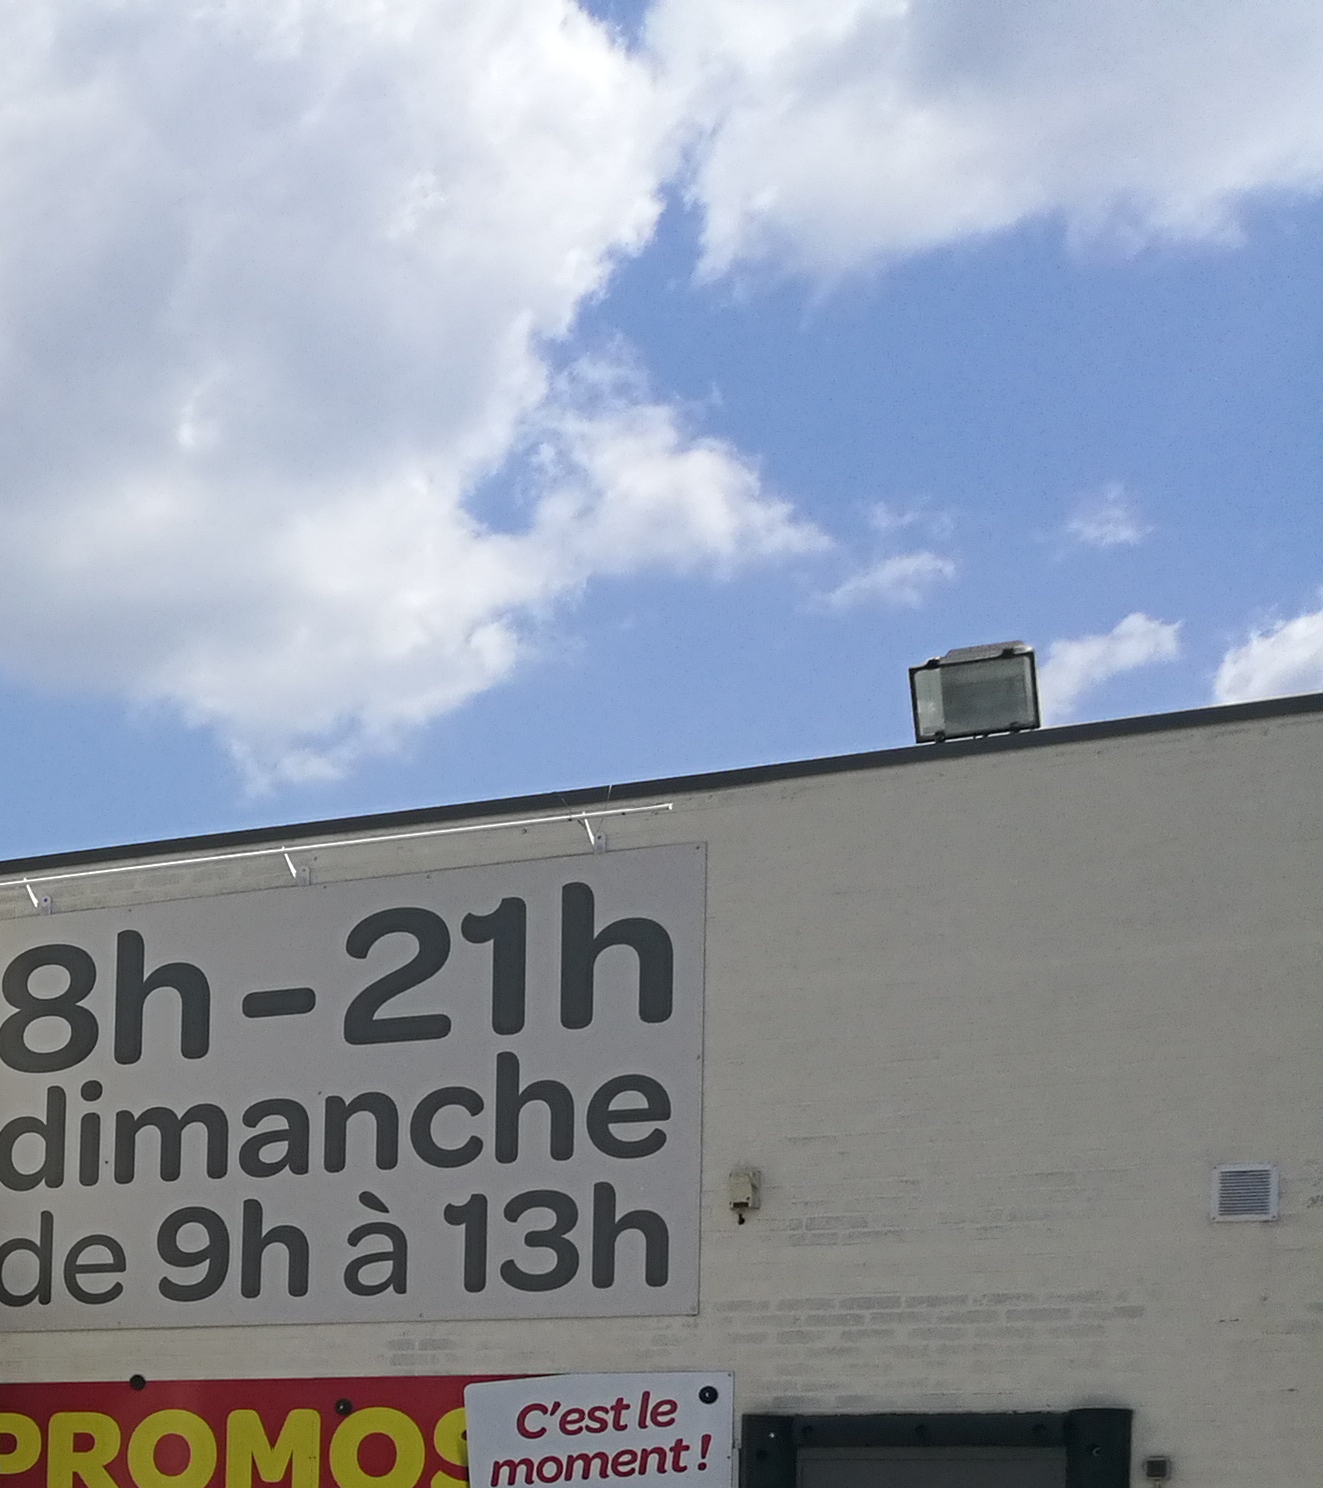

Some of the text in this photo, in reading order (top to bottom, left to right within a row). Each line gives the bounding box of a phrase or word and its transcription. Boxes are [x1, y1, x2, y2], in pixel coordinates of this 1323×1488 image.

[156, 1198, 311, 1302] 9h
[342, 1191, 409, 1297] à
[443, 1181, 670, 1292] 13h
[516, 1390, 679, 1439] C'est le
